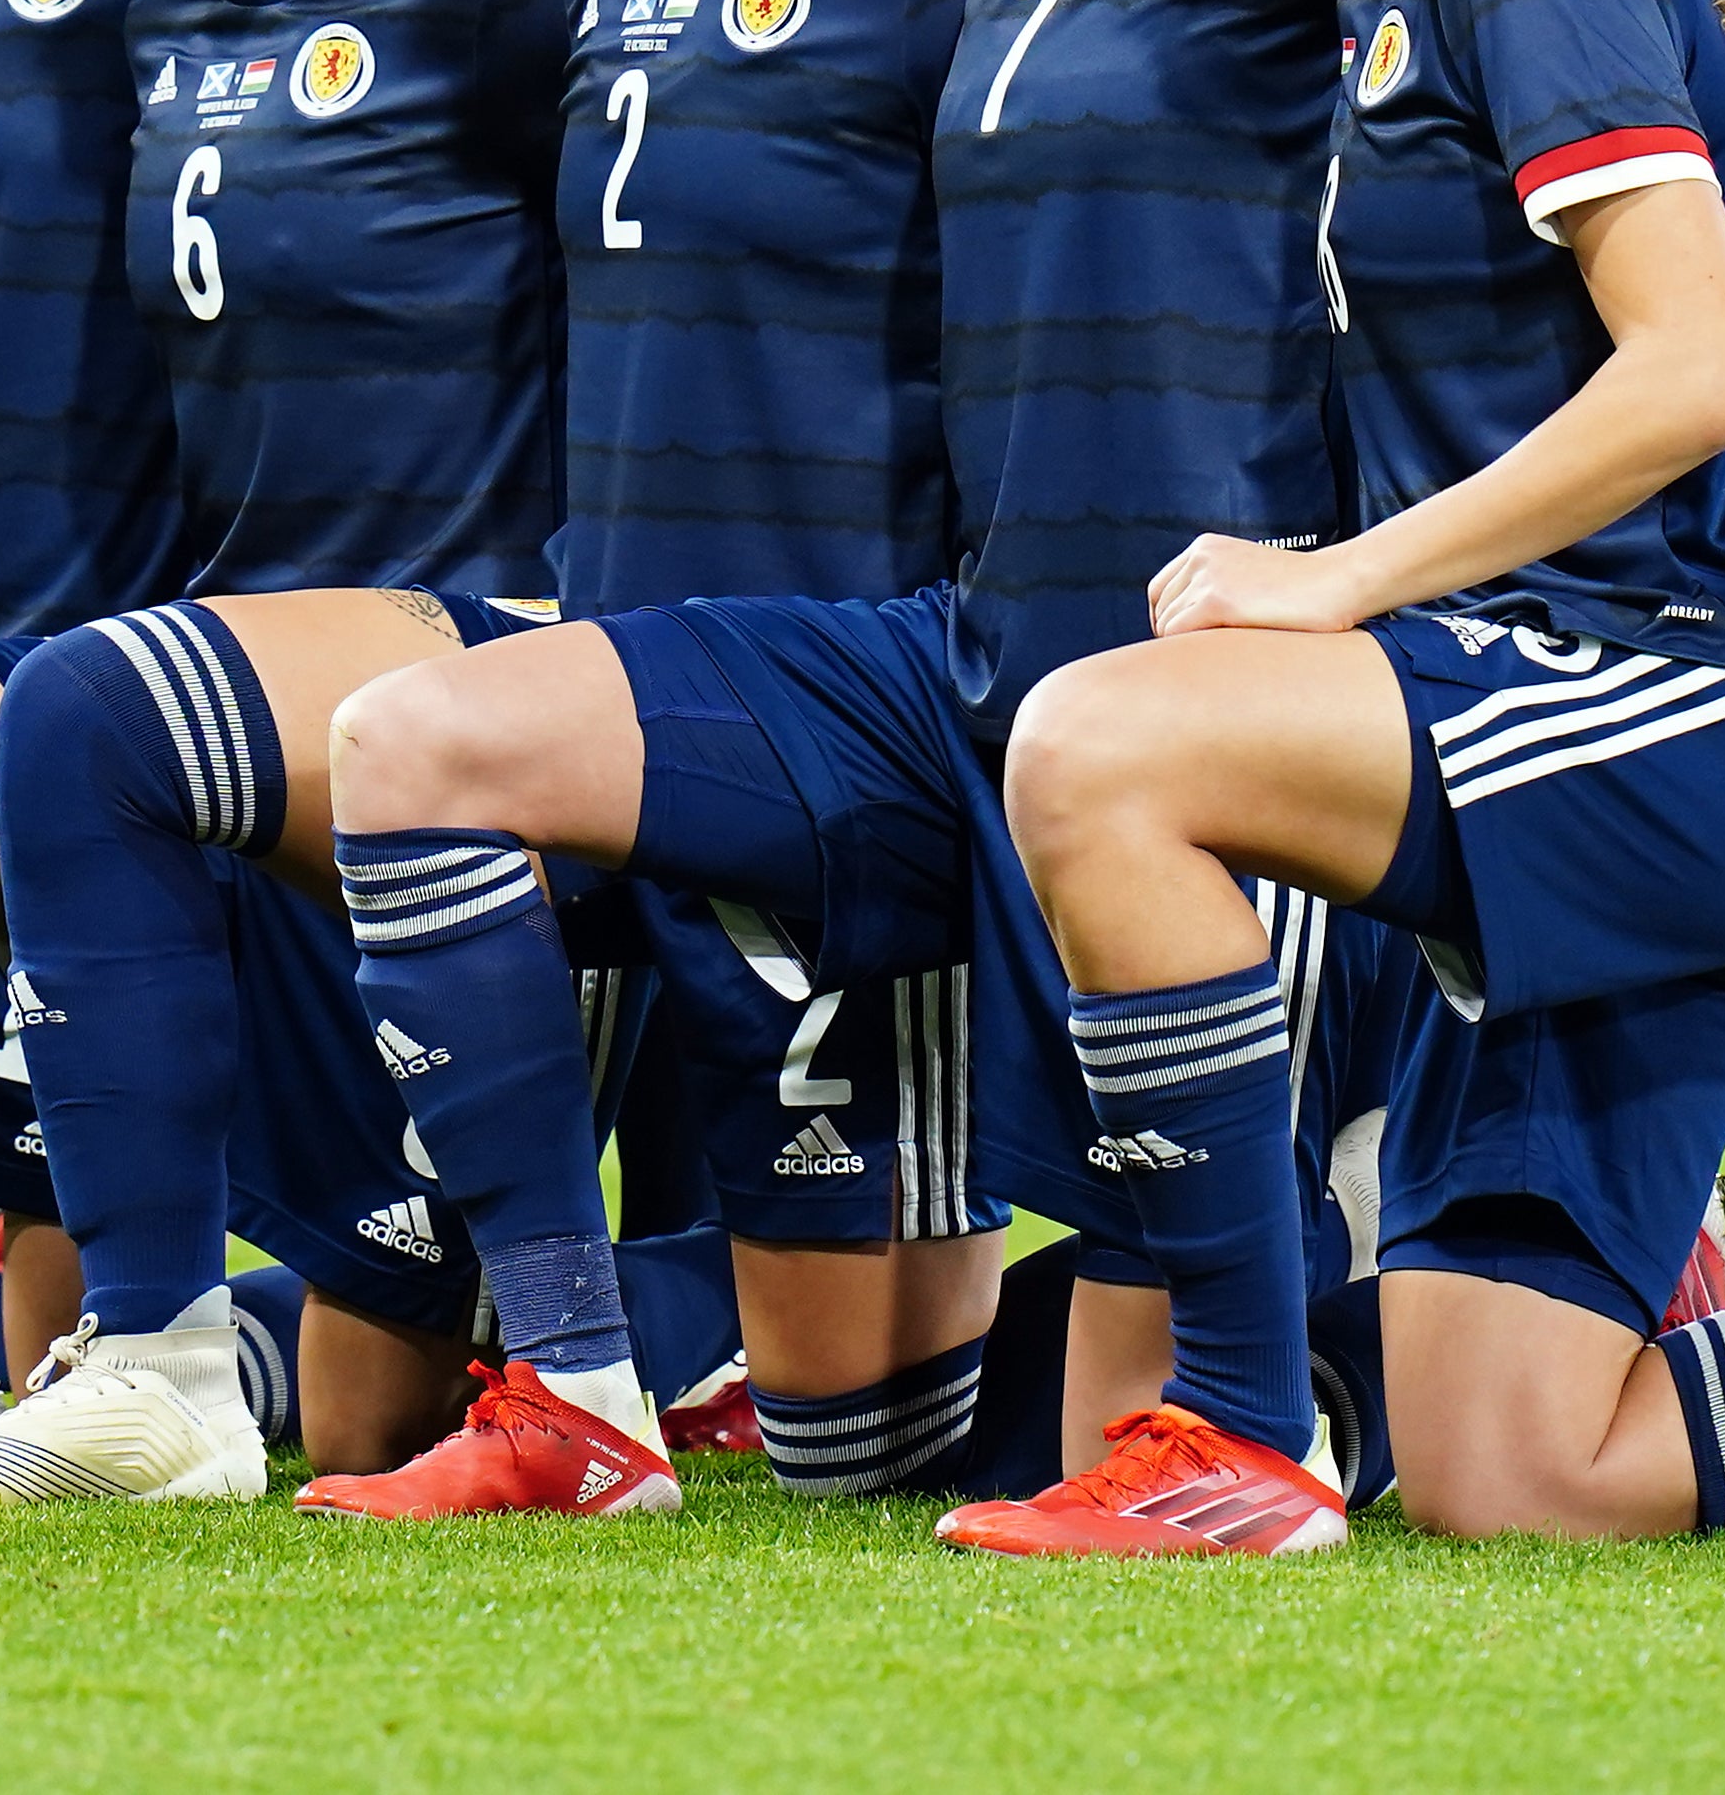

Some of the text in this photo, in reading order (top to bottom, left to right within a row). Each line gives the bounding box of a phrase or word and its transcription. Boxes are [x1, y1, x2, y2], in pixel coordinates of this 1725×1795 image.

[602, 68, 650, 250] 2
[172, 145, 225, 322] 6
[773, 1149, 866, 1178] adidas
[356, 1215, 444, 1265] adidas
[576, 1470, 624, 1504] adidas
